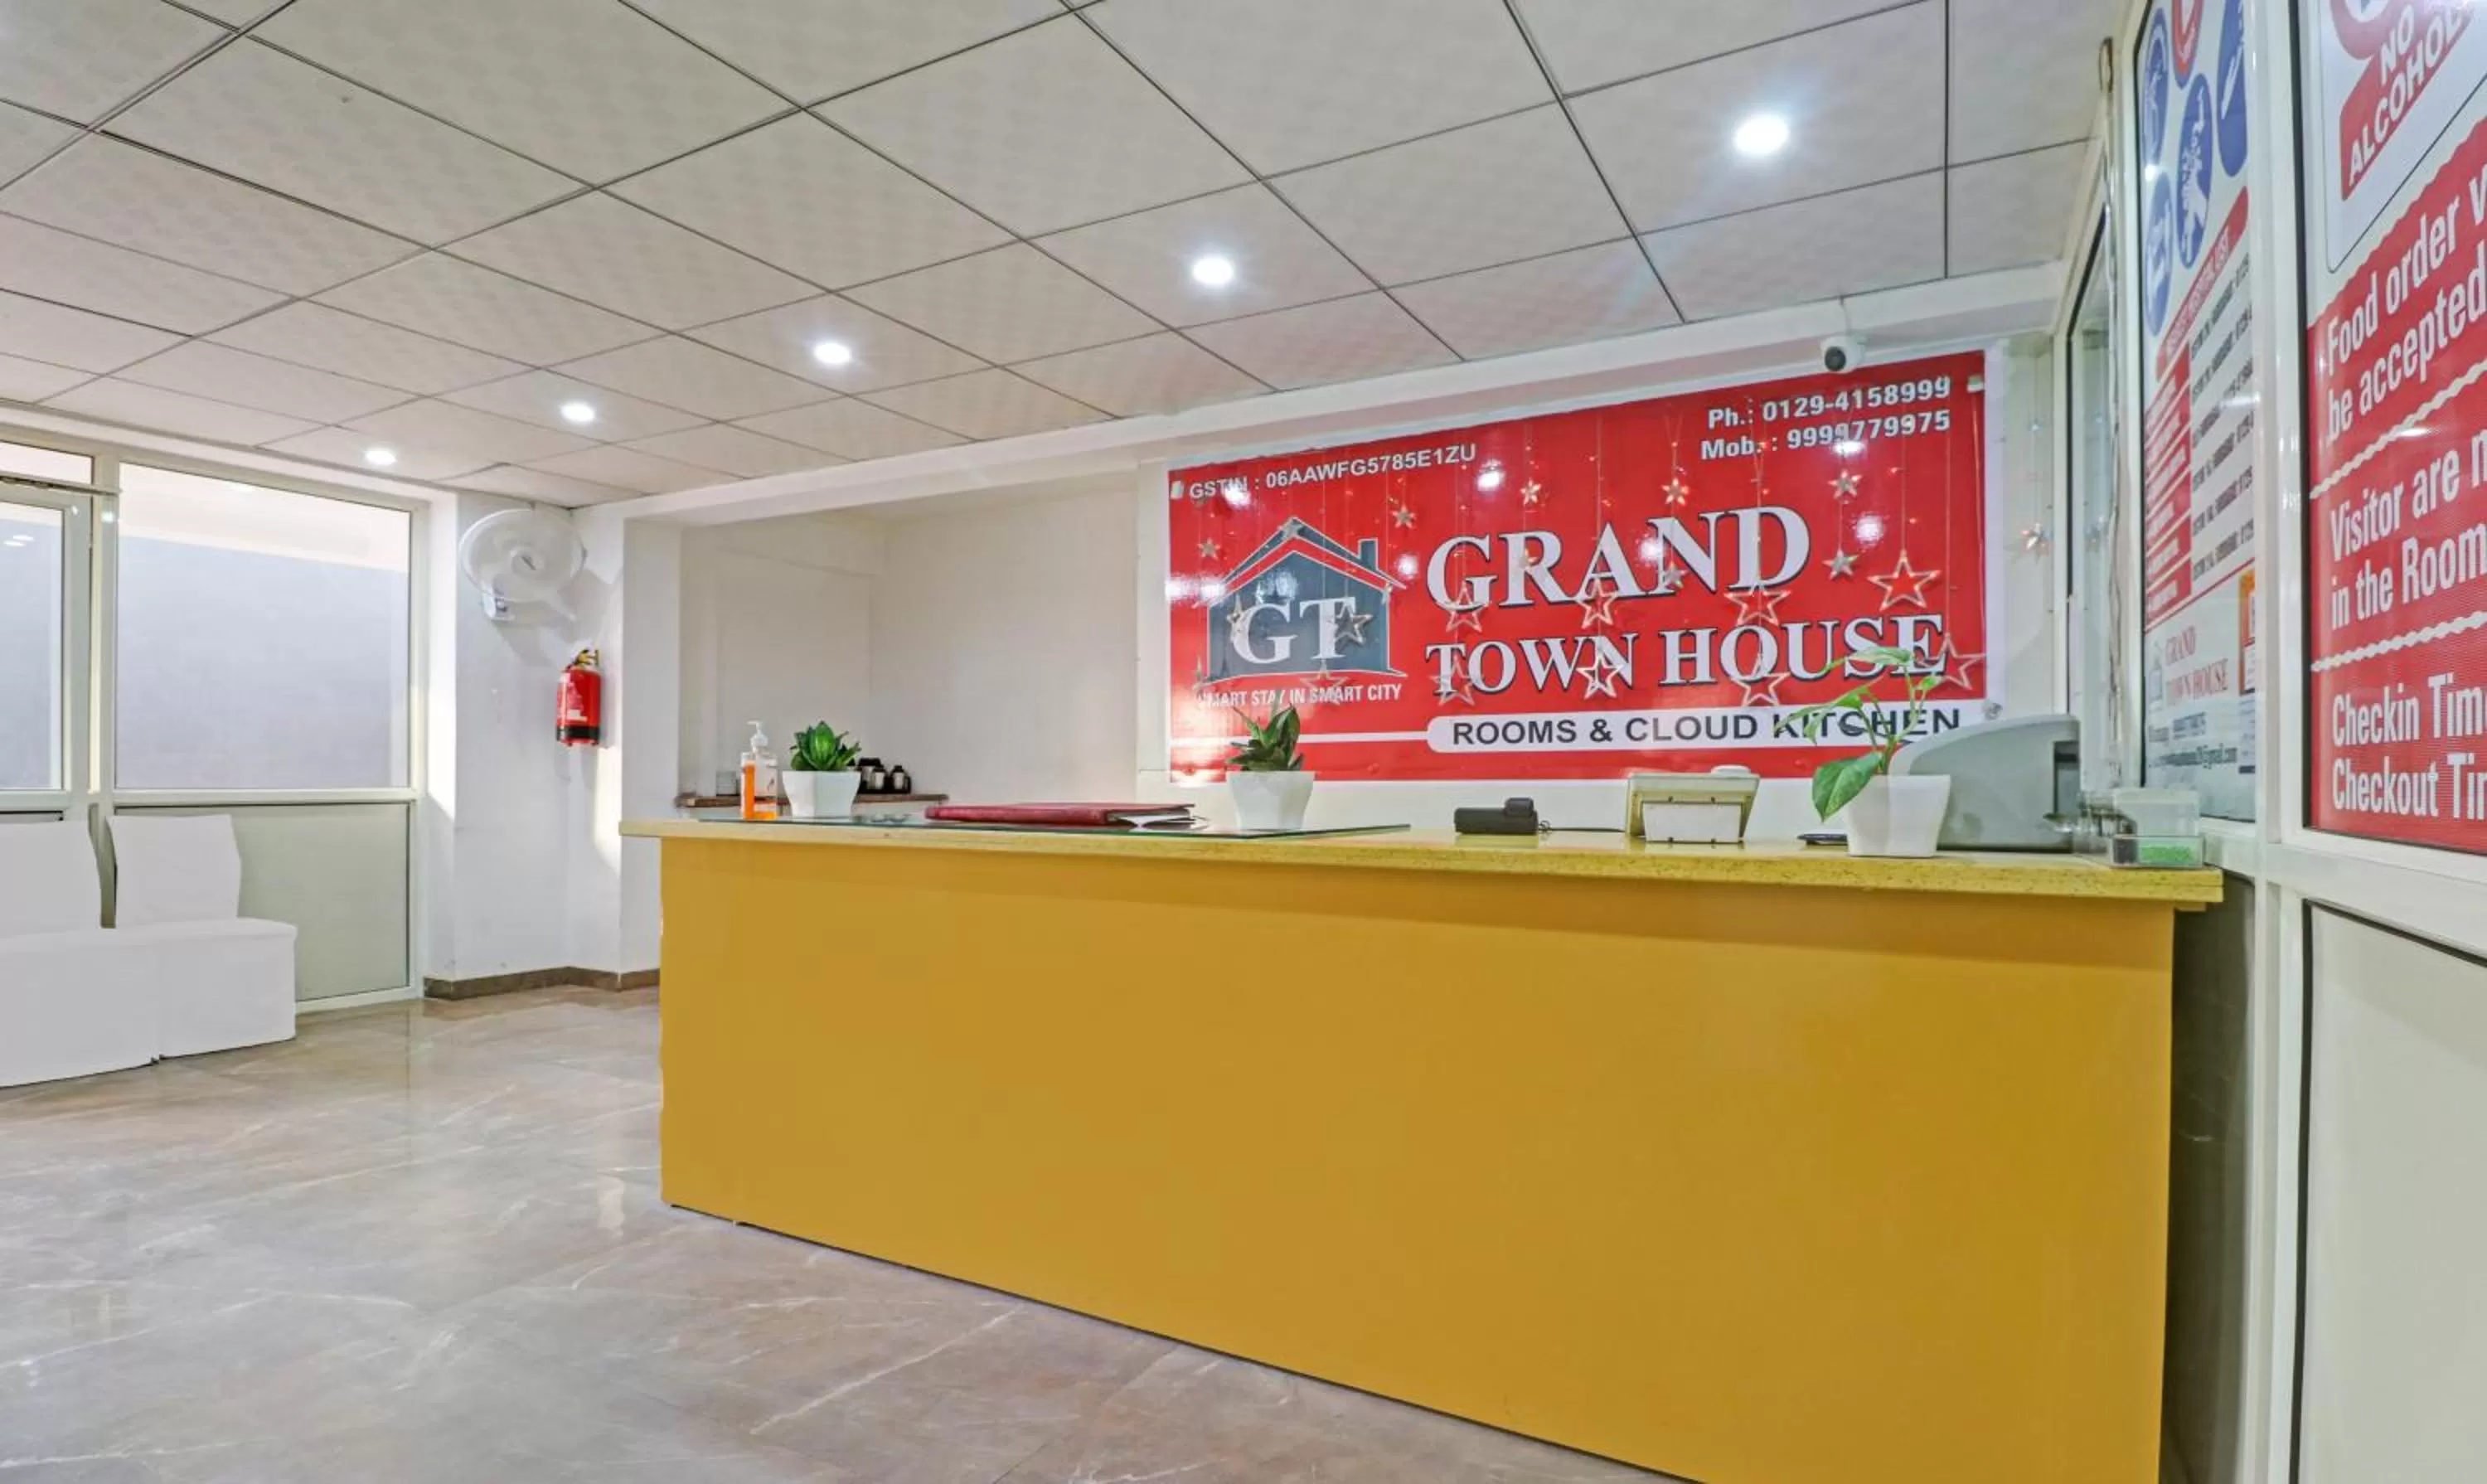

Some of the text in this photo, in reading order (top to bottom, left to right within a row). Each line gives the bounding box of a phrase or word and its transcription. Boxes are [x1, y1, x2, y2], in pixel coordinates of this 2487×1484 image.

[2380, 4, 2415, 86] NO
[2328, 270, 2378, 377] Food
[2386, 195, 2460, 316] order
[2326, 239, 2487, 448] be accepted
[1762, 376, 1951, 422] 0129-4158999
[1786, 410, 1951, 449] 9999779975
[1266, 443, 1476, 489] 06AAWFG5785E1ZU
[2330, 480, 2404, 562] Visitor
[2412, 449, 2460, 519] are
[1425, 505, 1813, 612] GRAND
[1230, 596, 1357, 664] GT
[2332, 575, 2349, 630] in
[2356, 559, 2393, 621] the
[1424, 613, 1947, 695] TOWN HOUSE
[1290, 687, 1307, 705] IN
[1310, 686, 1363, 704] SMART
[1367, 683, 1403, 701] CITY
[1452, 708, 1960, 745] ROOMS & CLOUD KITCHEN
[2333, 682, 2421, 746] Checkin
[2427, 672, 2487, 740] Tim
[2333, 755, 2440, 817] Checkout
